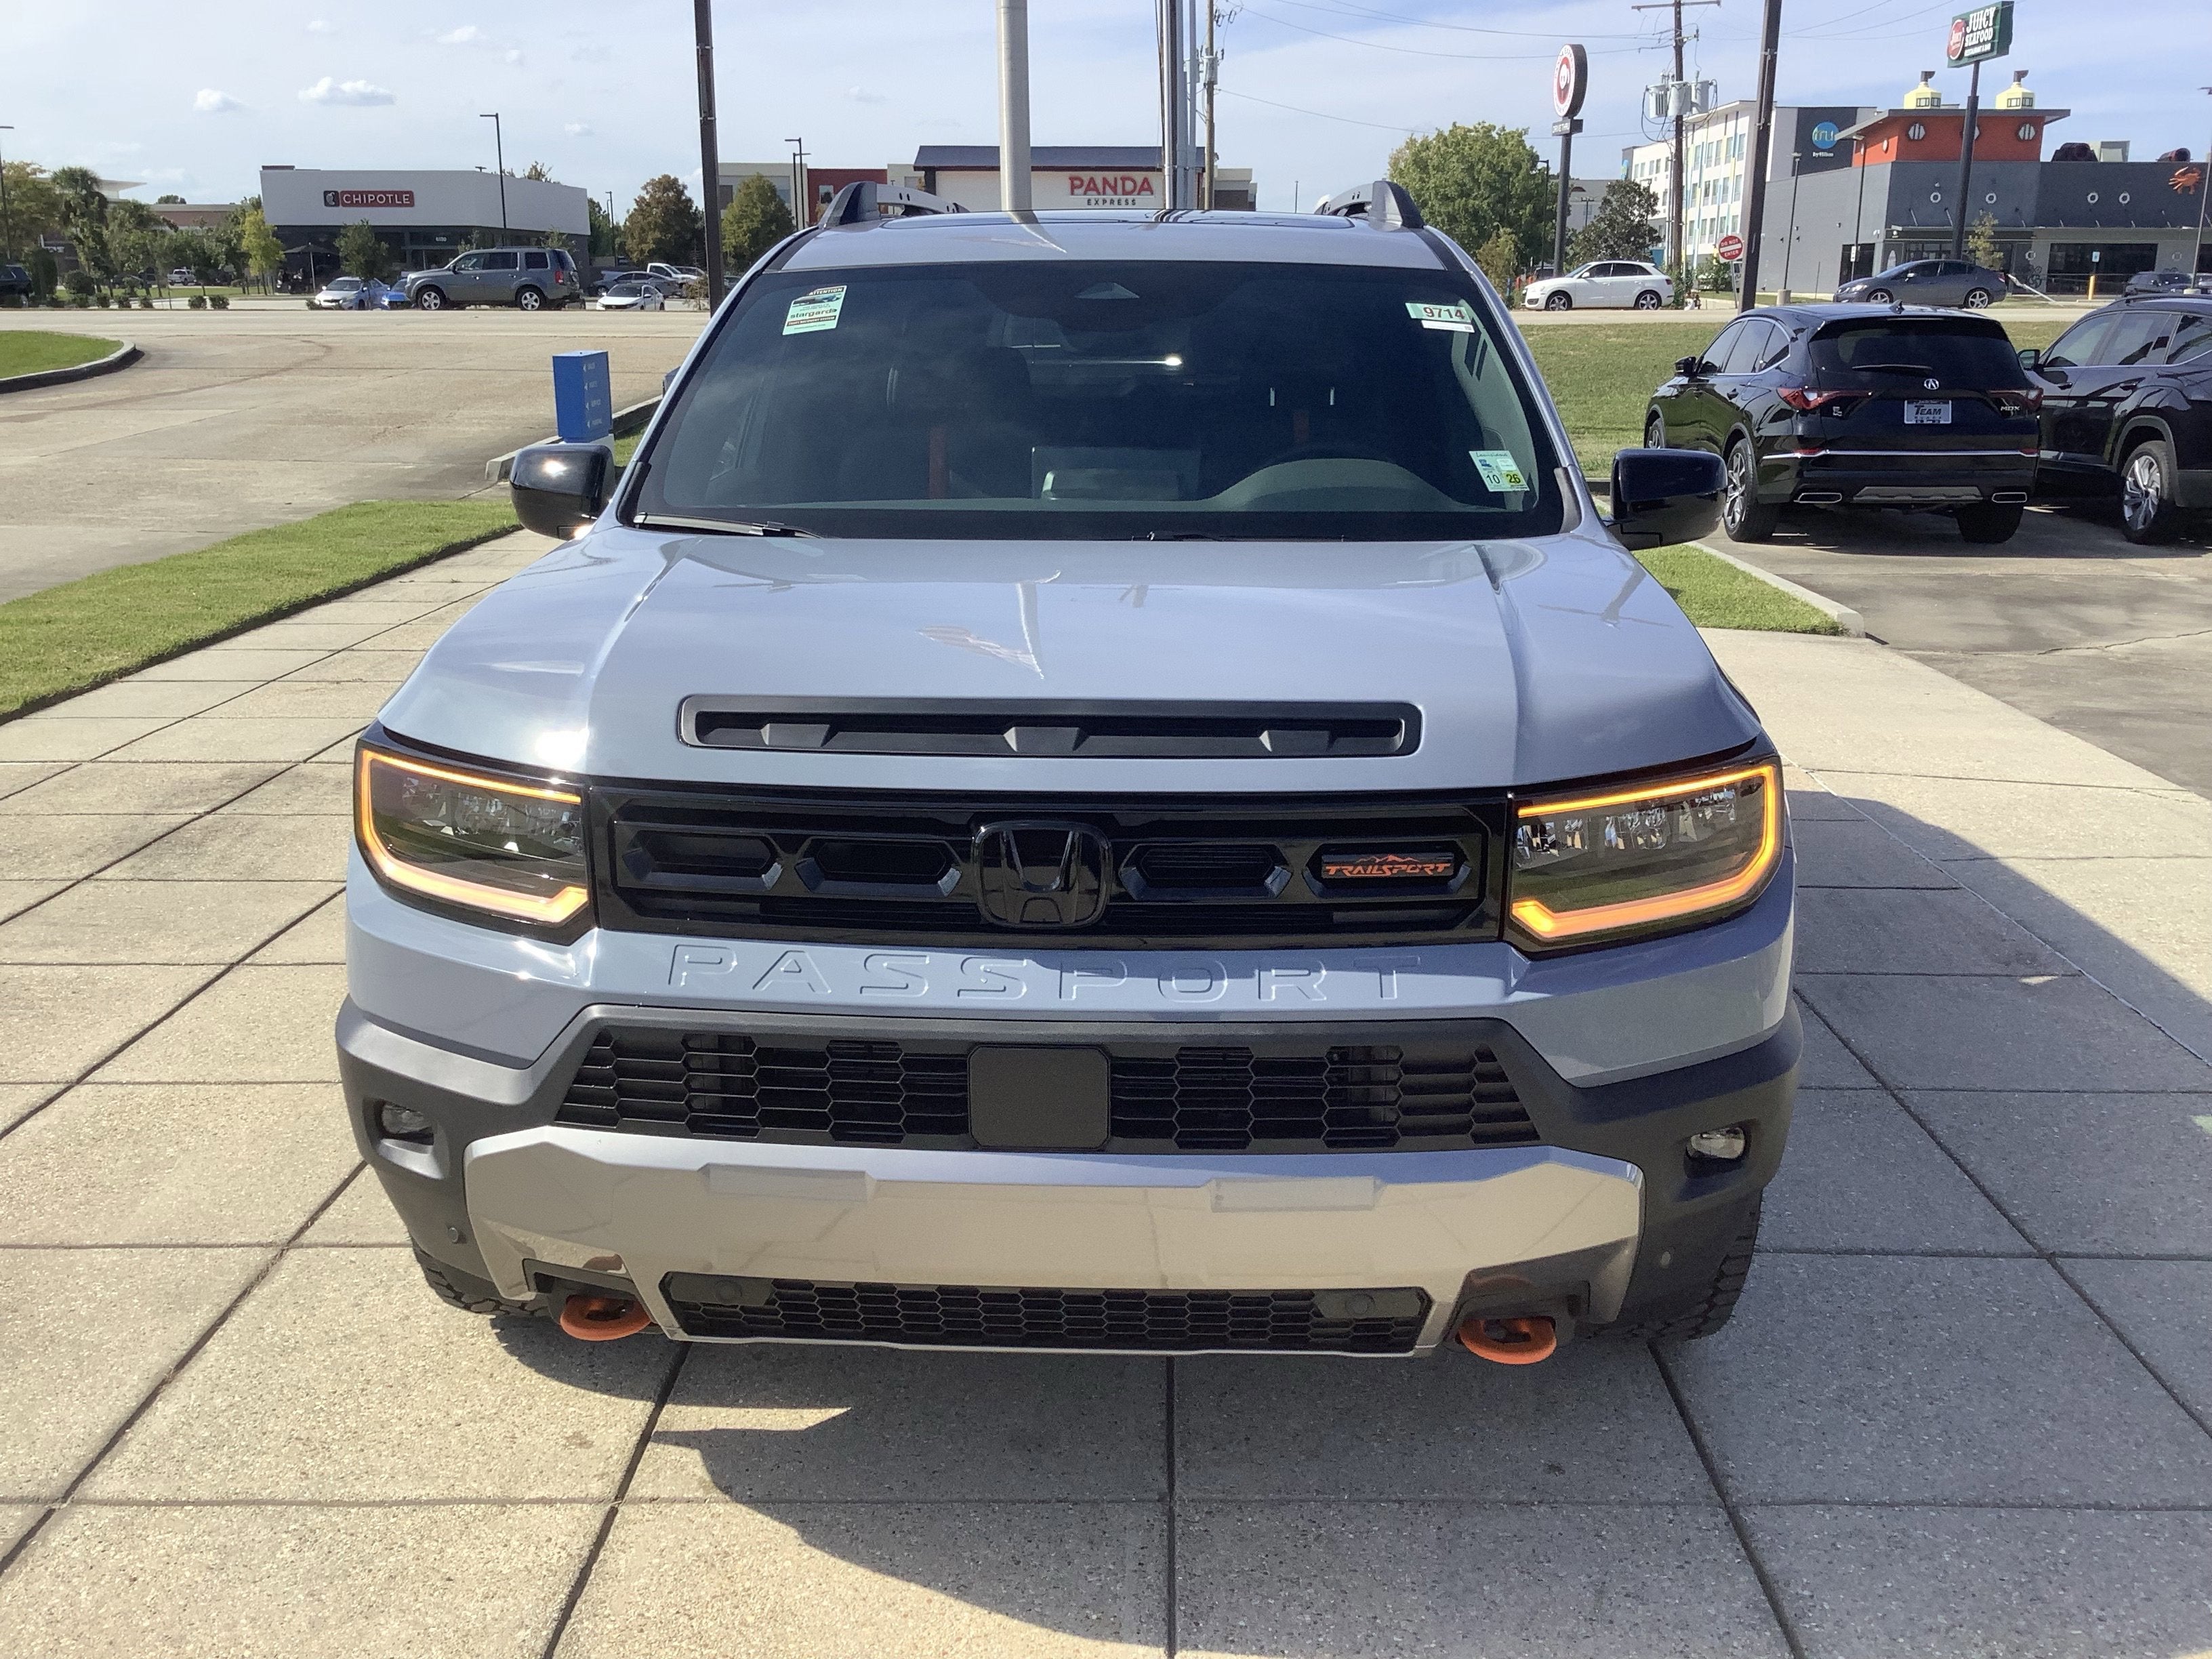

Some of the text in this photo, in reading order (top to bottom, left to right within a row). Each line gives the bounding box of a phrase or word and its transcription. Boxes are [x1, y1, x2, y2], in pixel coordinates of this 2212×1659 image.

[1966, 6, 1996, 34] JUICY
[1965, 27, 1993, 47] SEAFOOD
[1069, 176, 1154, 195] PANDA
[343, 194, 410, 204] CHIPOTLE
[808, 287, 842, 295] ATTENTION
[1423, 307, 1465, 319] 9714
[1914, 405, 1942, 415] TEAM
[1486, 474, 1521, 484] 10 26
[1326, 863, 1451, 877] TRAILSPORT
[668, 943, 1422, 1003] PASSPORT
